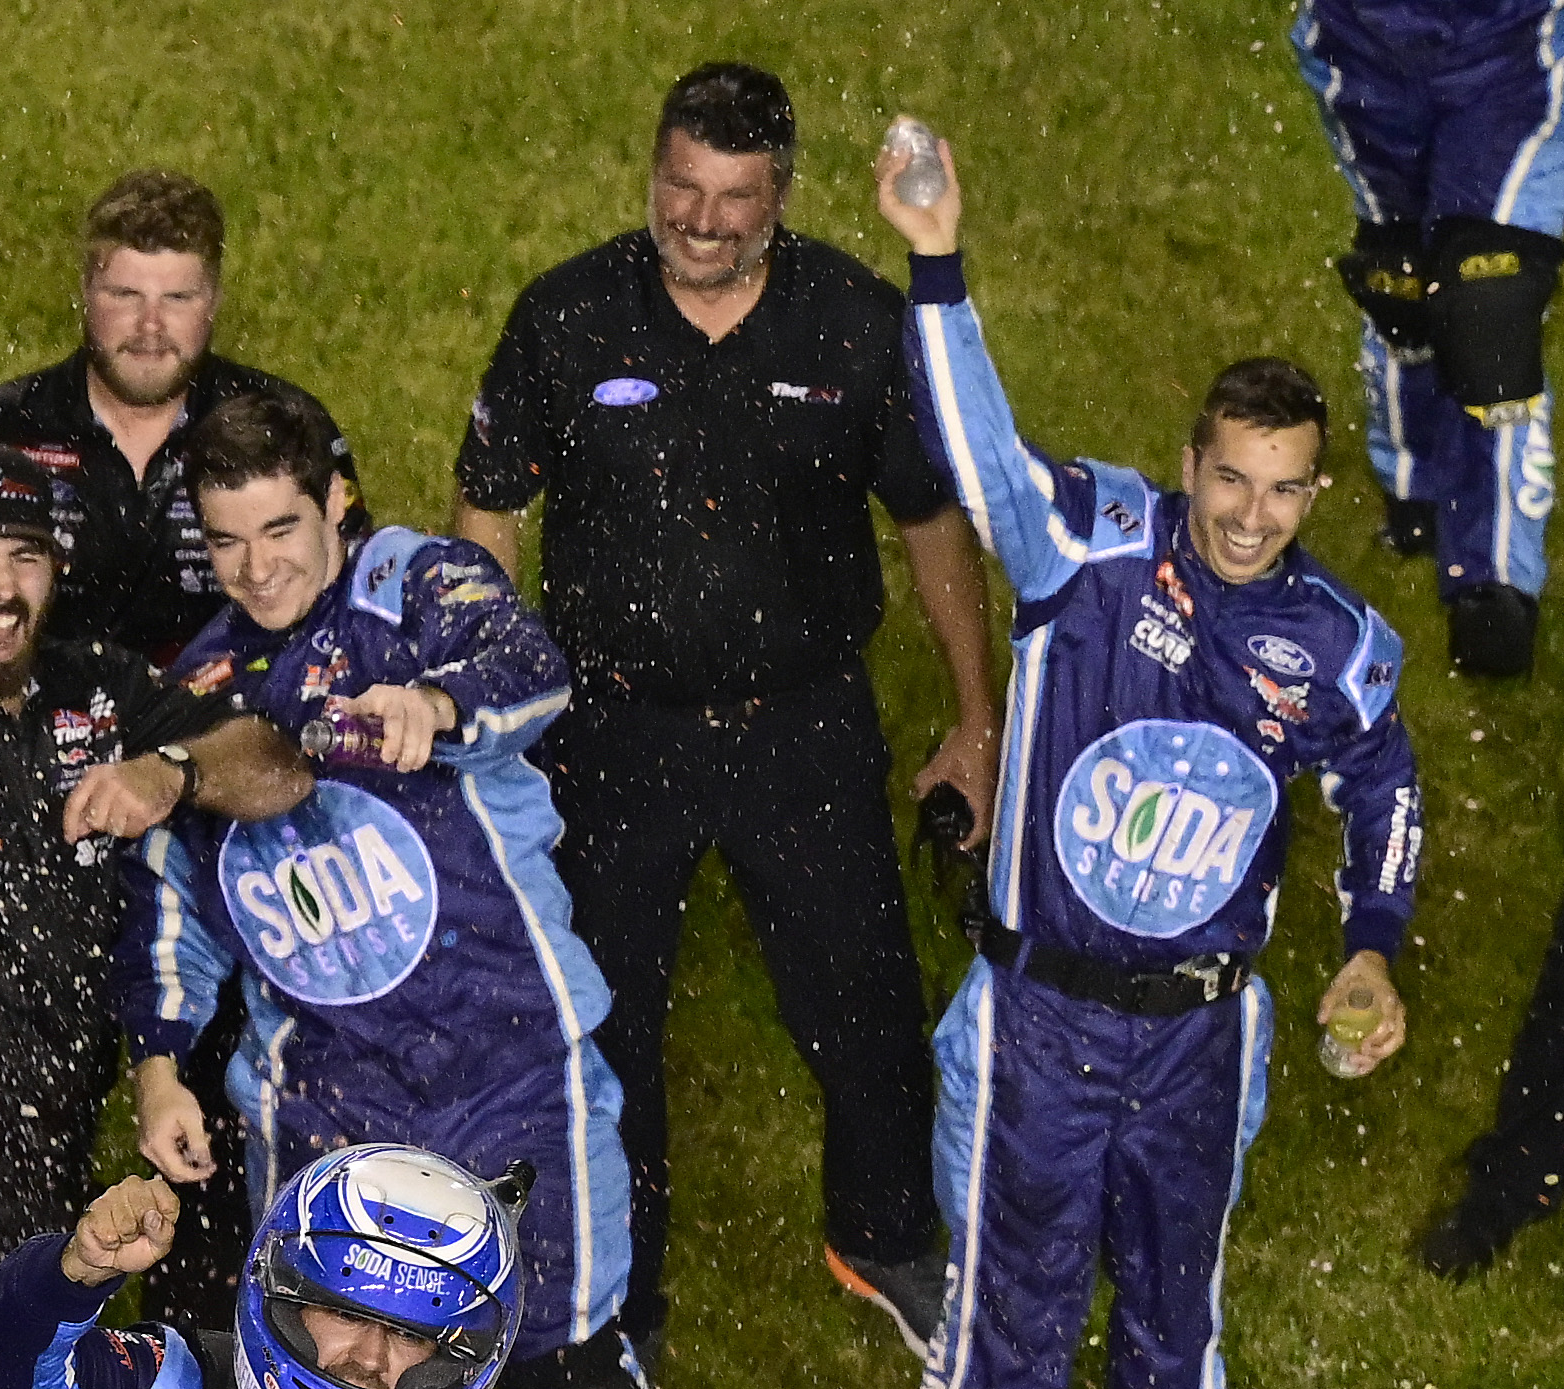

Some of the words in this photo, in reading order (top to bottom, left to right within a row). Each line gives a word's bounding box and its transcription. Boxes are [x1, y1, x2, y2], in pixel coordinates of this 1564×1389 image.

[1073, 757, 1254, 885] SODA
[236, 823, 425, 959] SODA
[1075, 846, 1208, 917] SENSE
[288, 914, 416, 989] SENSE
[343, 1243, 392, 1281] SODA
